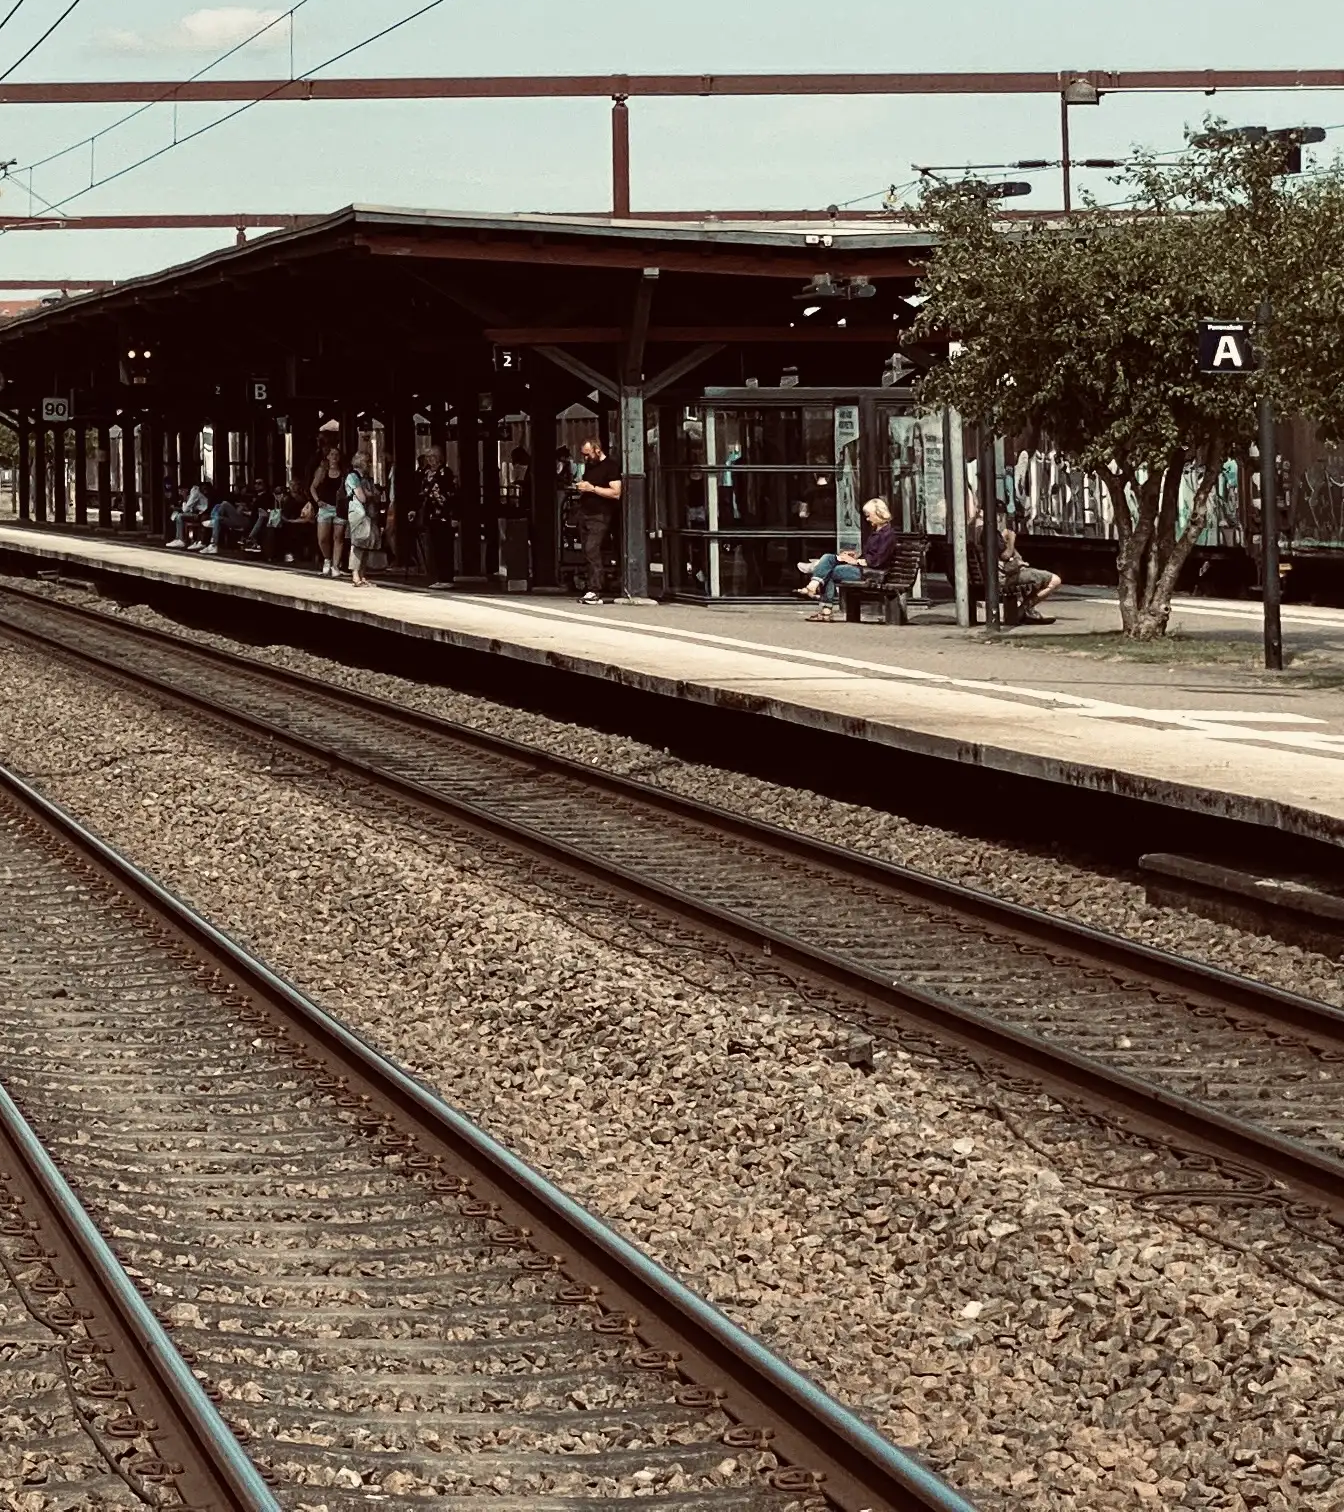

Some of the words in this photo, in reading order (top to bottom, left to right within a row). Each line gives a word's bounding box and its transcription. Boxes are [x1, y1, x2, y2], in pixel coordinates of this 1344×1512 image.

[1212, 335, 1243, 367] A
[504, 356, 512, 366] 2
[255, 384, 267, 399] B
[44, 402, 67, 417] 90
